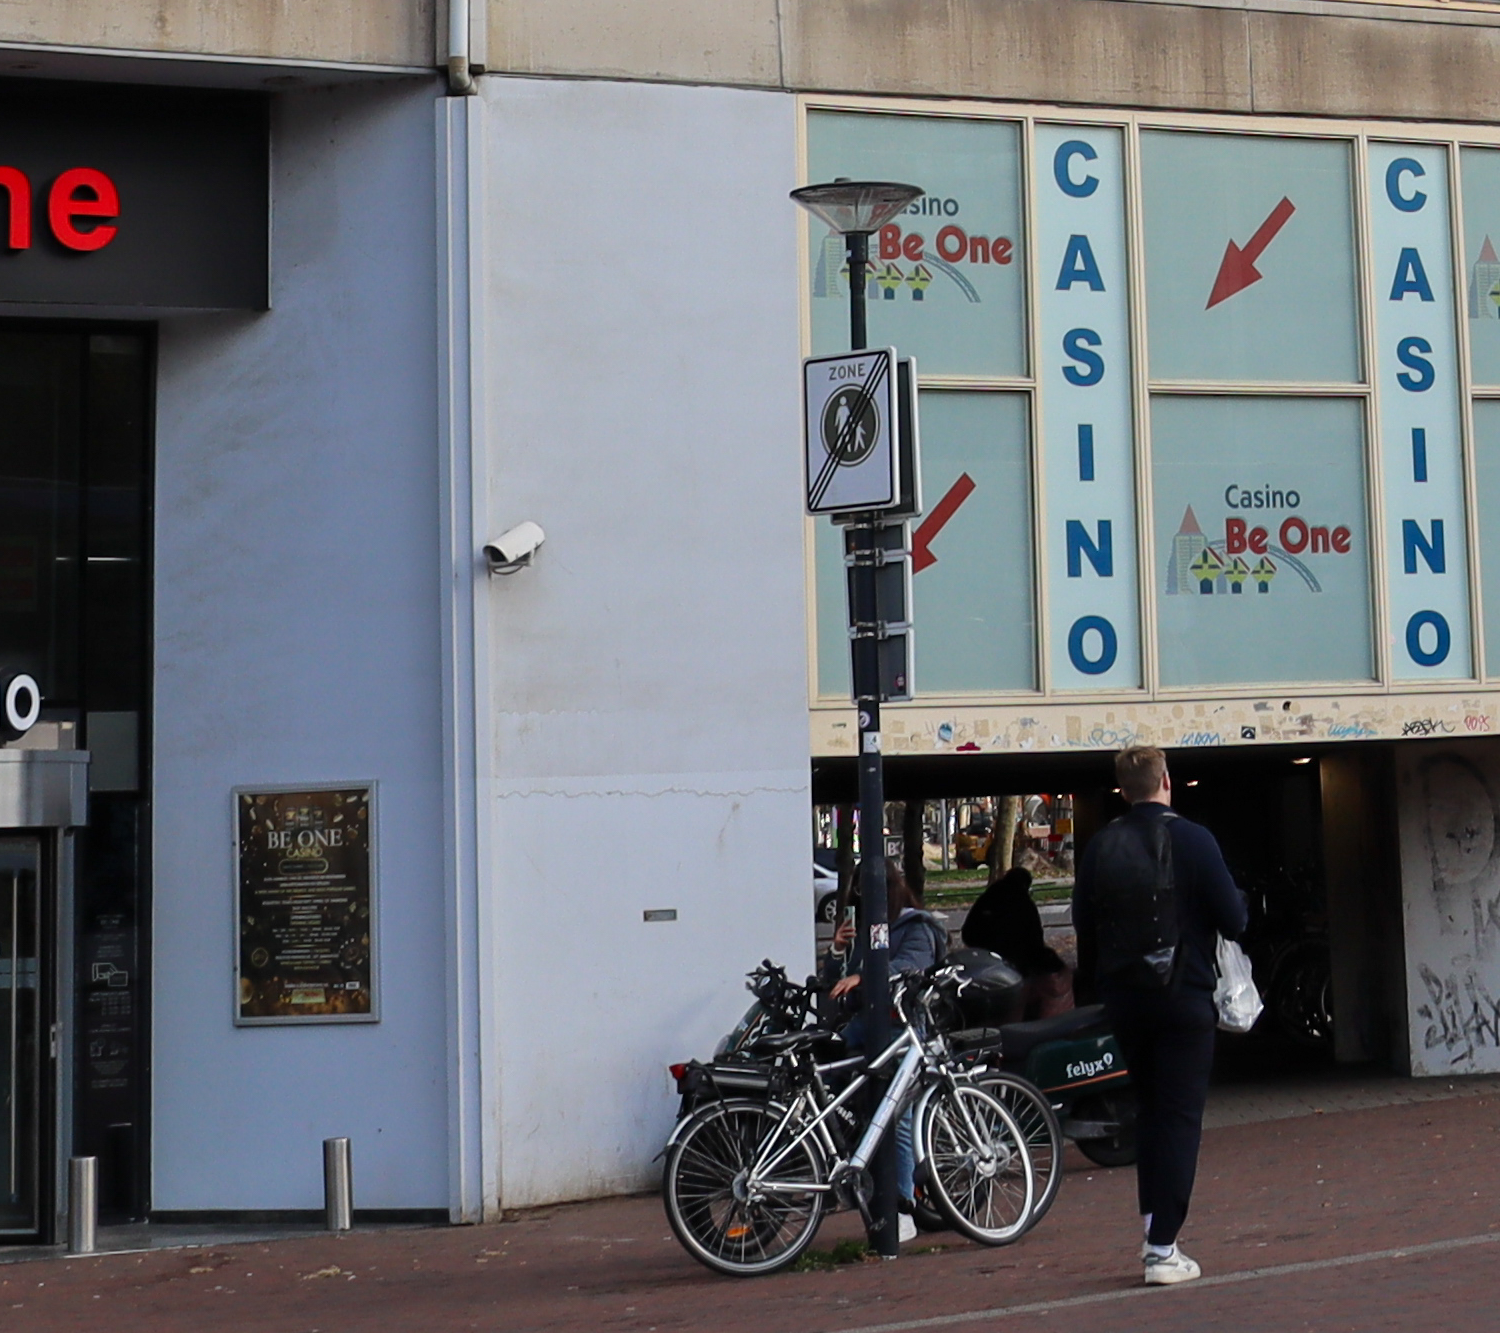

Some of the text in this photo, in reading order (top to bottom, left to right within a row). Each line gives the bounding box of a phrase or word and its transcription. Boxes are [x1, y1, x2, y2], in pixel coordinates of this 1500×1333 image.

[879, 222, 1013, 265] Be One
[829, 363, 866, 380] ZONE
[1052, 139, 1118, 675] CASINO
[1385, 157, 1451, 667] CASINO
[1225, 484, 1300, 509] Casino
[1225, 516, 1351, 555] Be One
[268, 828, 343, 849] BE ONE
[1066, 1060, 1105, 1079] felyx
